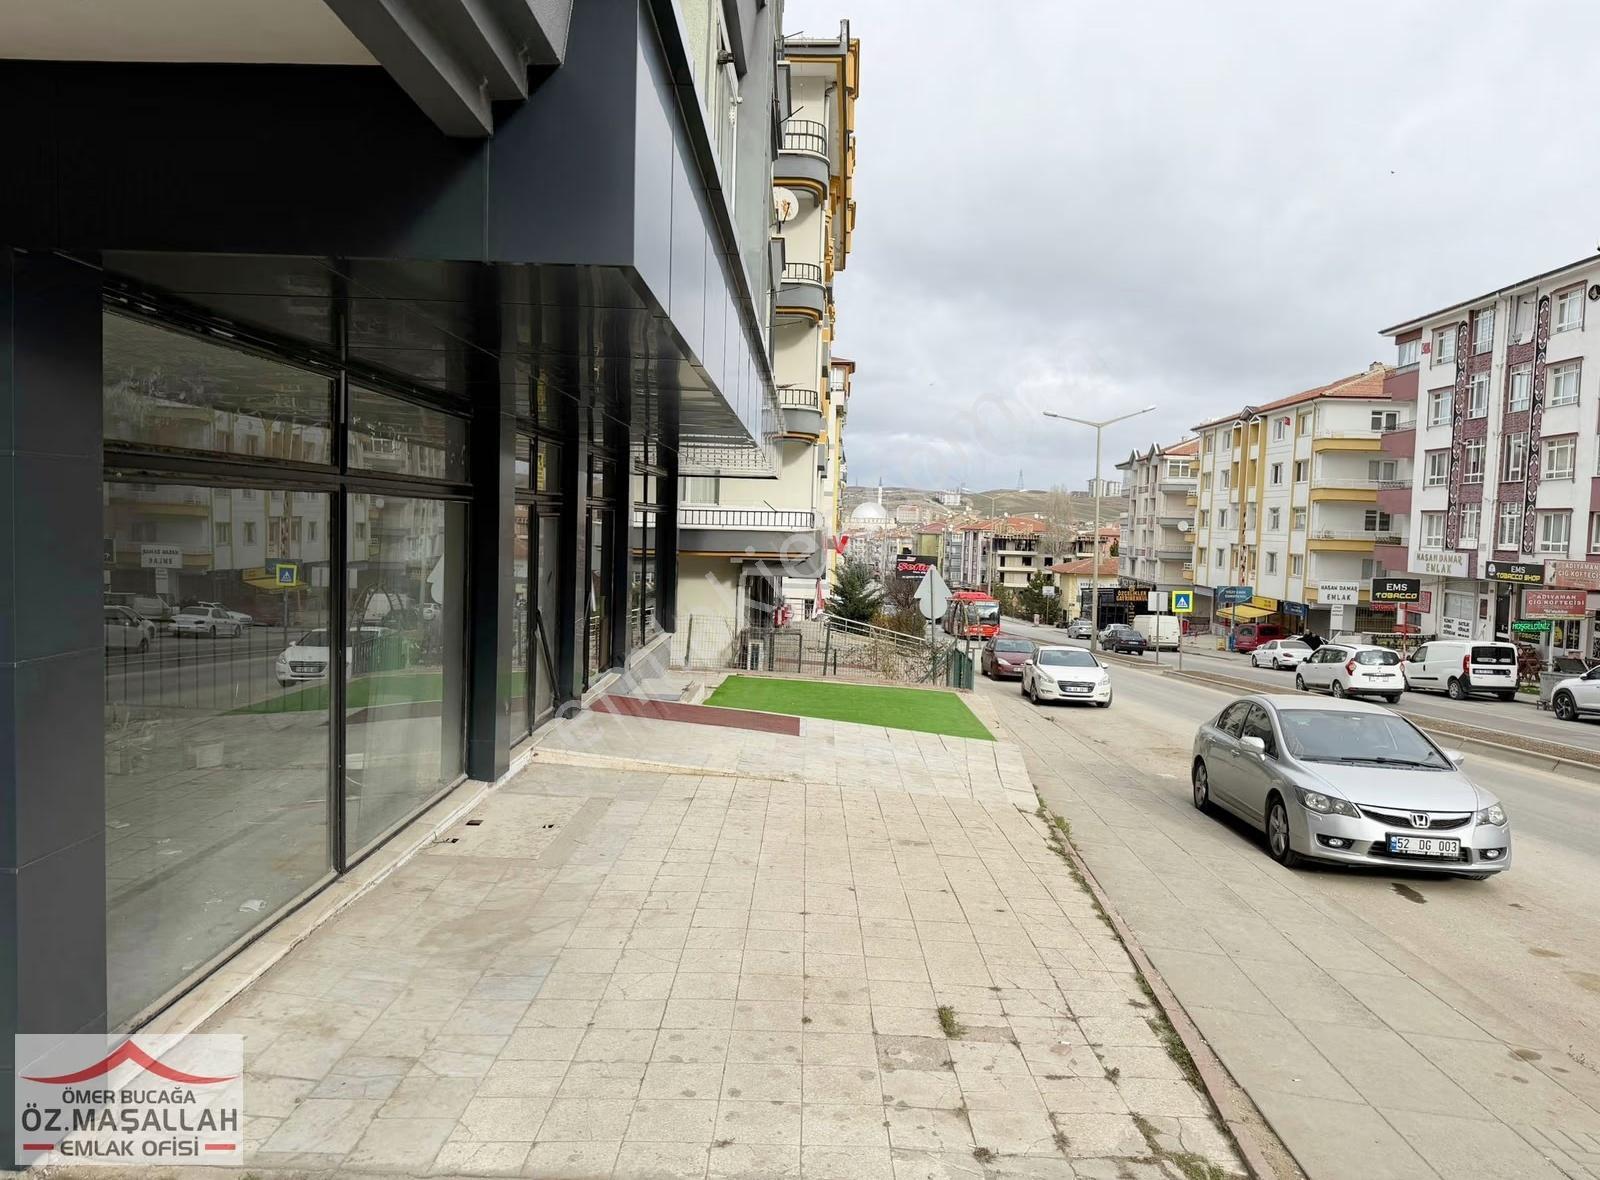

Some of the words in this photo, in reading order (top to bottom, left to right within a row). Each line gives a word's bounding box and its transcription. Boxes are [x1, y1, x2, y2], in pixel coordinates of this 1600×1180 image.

[1425, 563, 1451, 574] EMLAK
[1510, 565, 1526, 574] EMS
[1496, 572, 1523, 581] TOBACCO
[1524, 574, 1541, 582] SHOP
[1386, 583, 1408, 592] EMS
[1327, 593, 1352, 601] EMLAK
[1375, 592, 1418, 600] TOBACCO
[1397, 837, 1410, 849] 52
[1418, 839, 1431, 851] DG
[1438, 840, 1457, 852] 003
